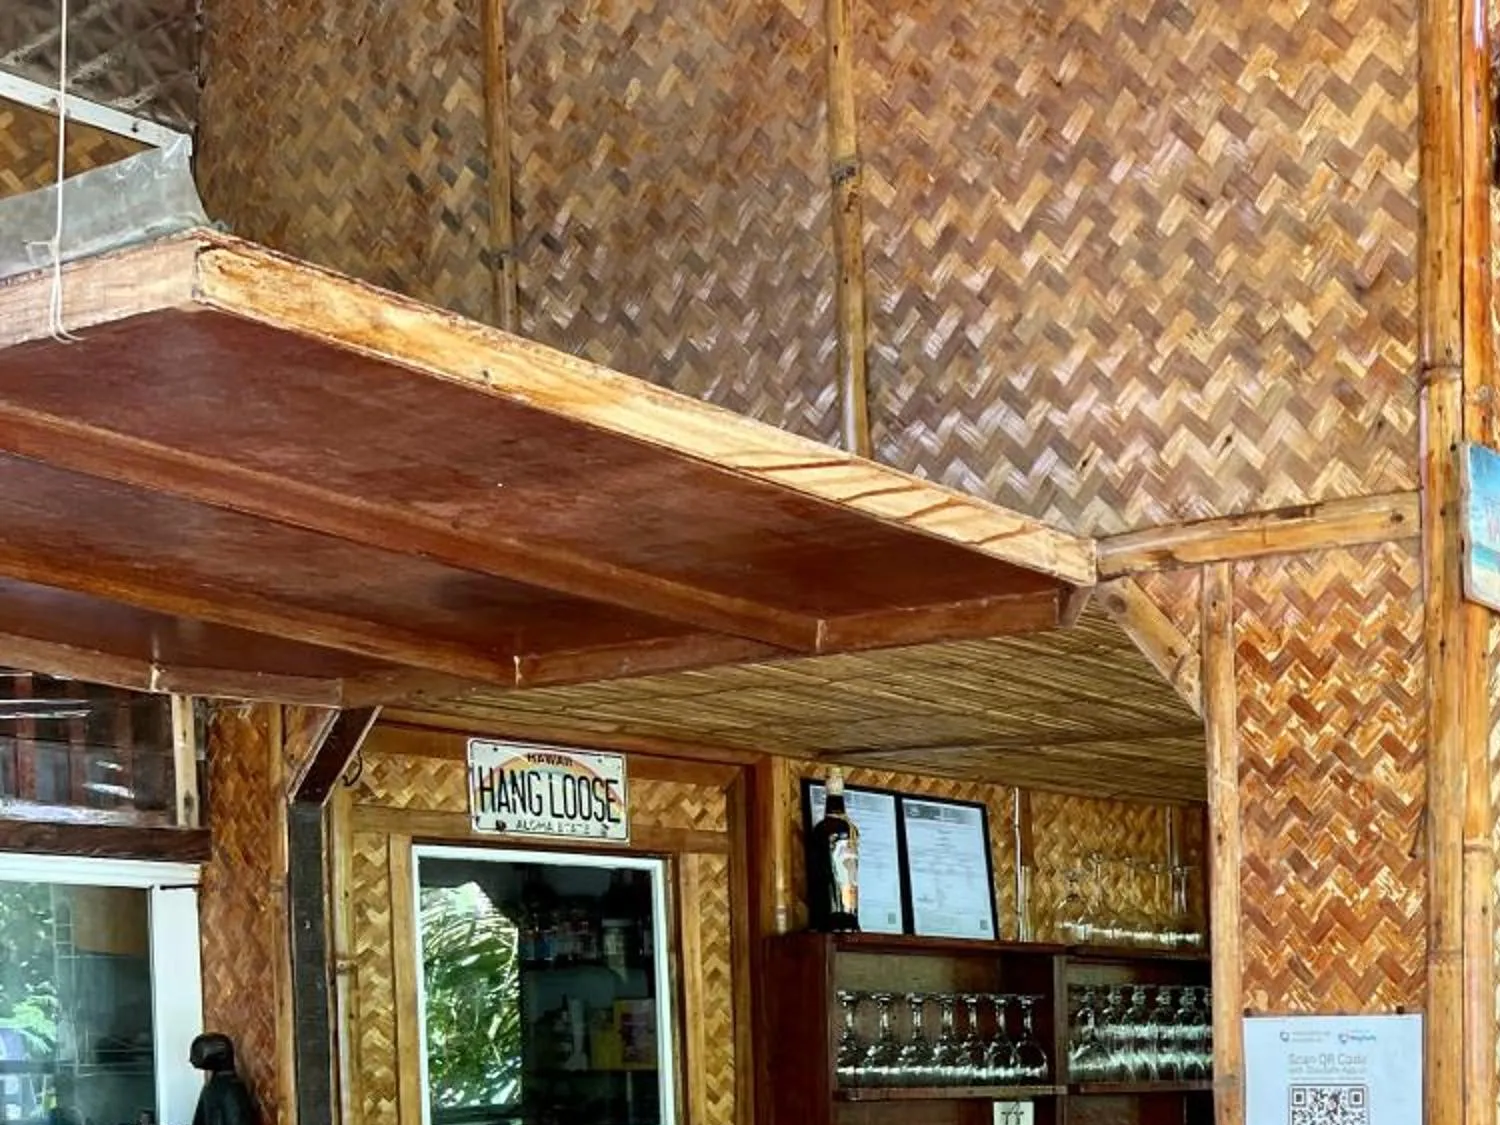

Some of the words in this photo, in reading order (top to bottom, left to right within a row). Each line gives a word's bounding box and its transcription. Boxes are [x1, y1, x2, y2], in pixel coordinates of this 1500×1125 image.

[527, 752, 574, 767] HAWAII
[478, 766, 543, 817] HANG
[547, 772, 622, 823] LOOSE
[515, 819, 553, 832] ALOHA
[557, 822, 590, 835] STATE
